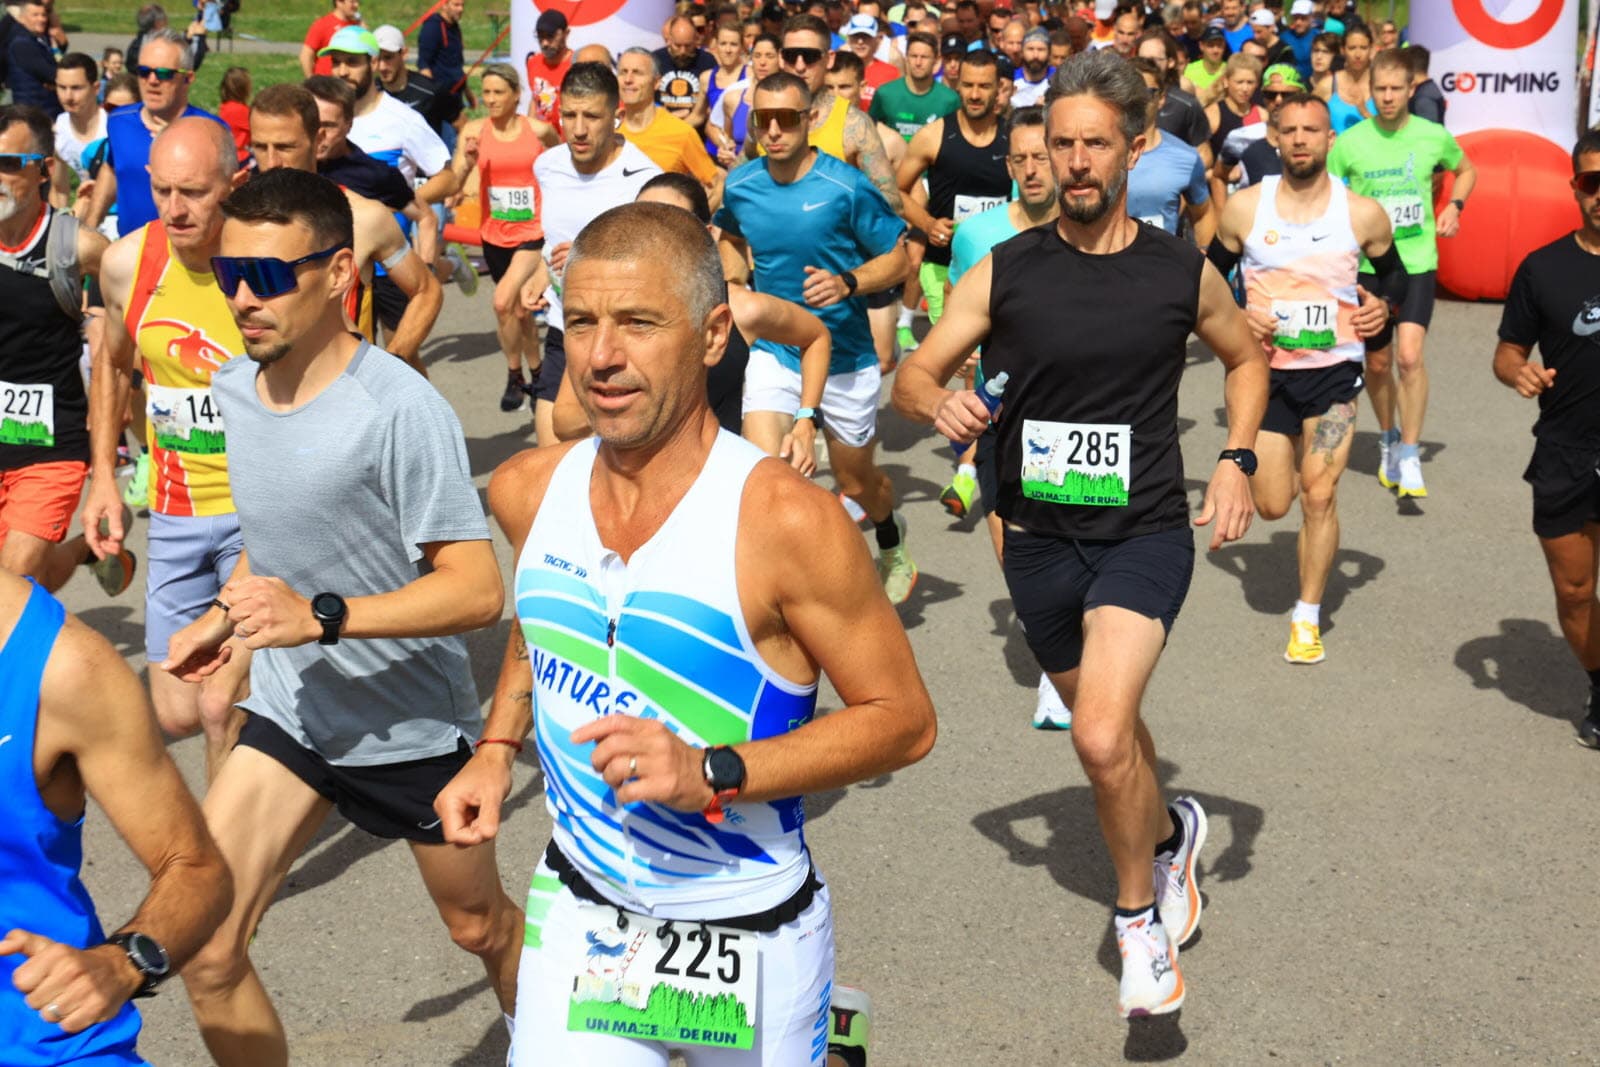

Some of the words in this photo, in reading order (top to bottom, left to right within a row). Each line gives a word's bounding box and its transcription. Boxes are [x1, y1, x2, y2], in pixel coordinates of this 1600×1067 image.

[1441, 71, 1560, 94] GOTIMING
[508, 190, 529, 206] 198
[980, 200, 1003, 213] 10
[1394, 205, 1420, 224] 240
[1304, 305, 1328, 327] 171
[4, 388, 44, 417] 227
[186, 394, 222, 424] 14
[1066, 429, 1120, 468] 285
[654, 928, 742, 985] 225
[585, 1017, 610, 1032] UN
[679, 1026, 700, 1041] DE
[701, 1030, 738, 1045] RUN
